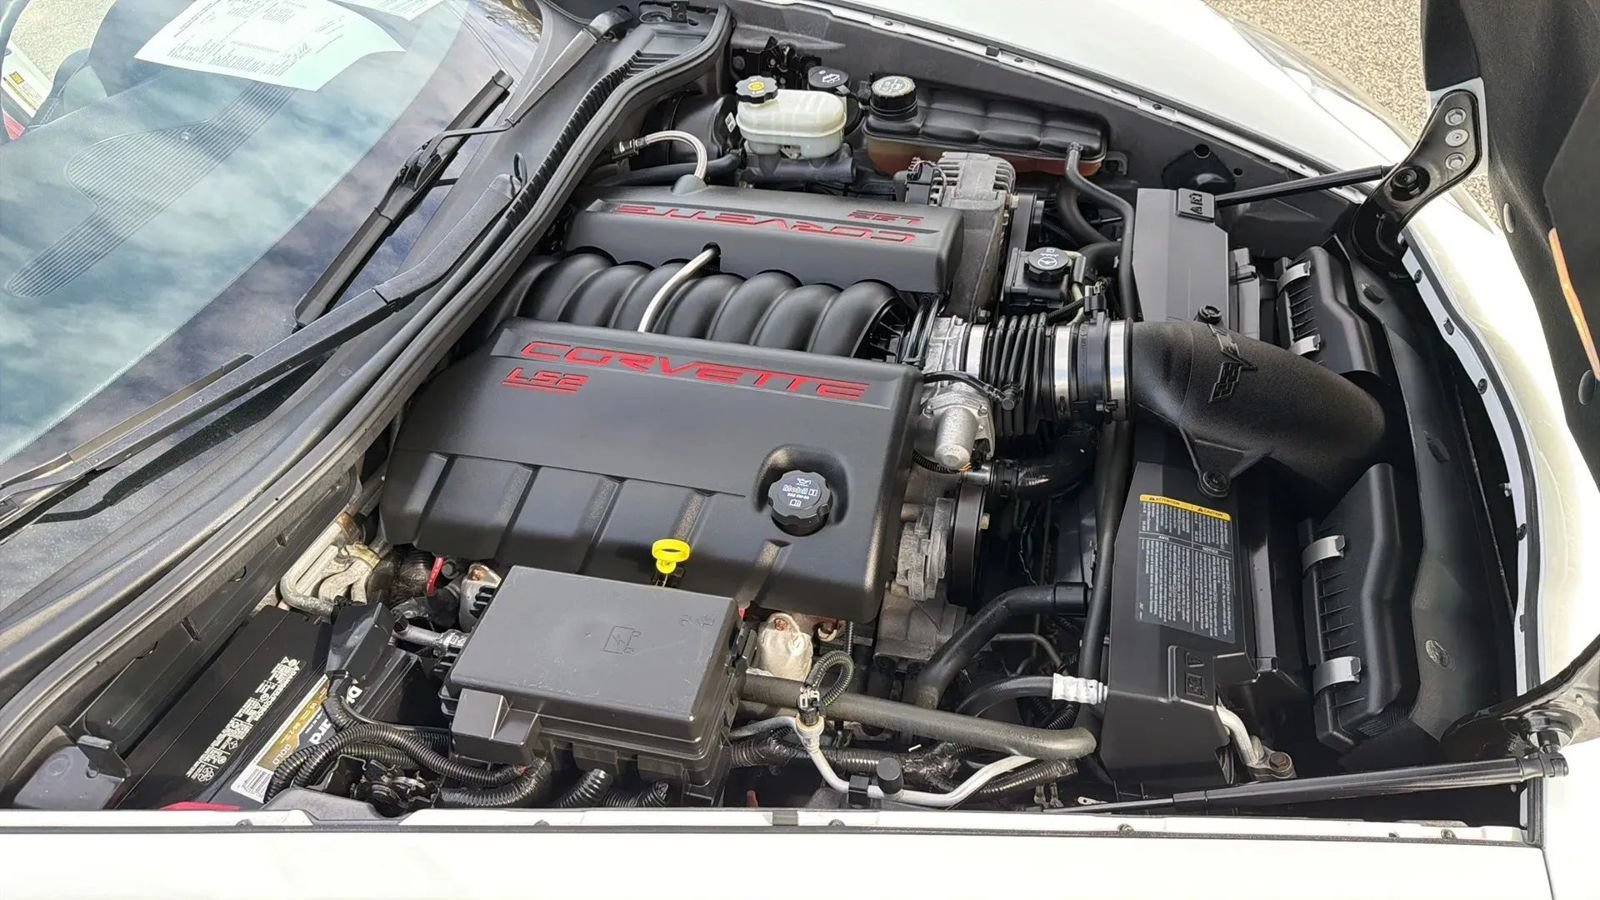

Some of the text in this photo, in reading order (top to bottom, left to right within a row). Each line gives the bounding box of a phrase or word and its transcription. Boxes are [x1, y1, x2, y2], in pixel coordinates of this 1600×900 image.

[615, 204, 916, 242] CORVETTE
[502, 367, 591, 395] LS2
[521, 341, 871, 400] CORVETTE
[272, 743, 292, 764] GOLD
